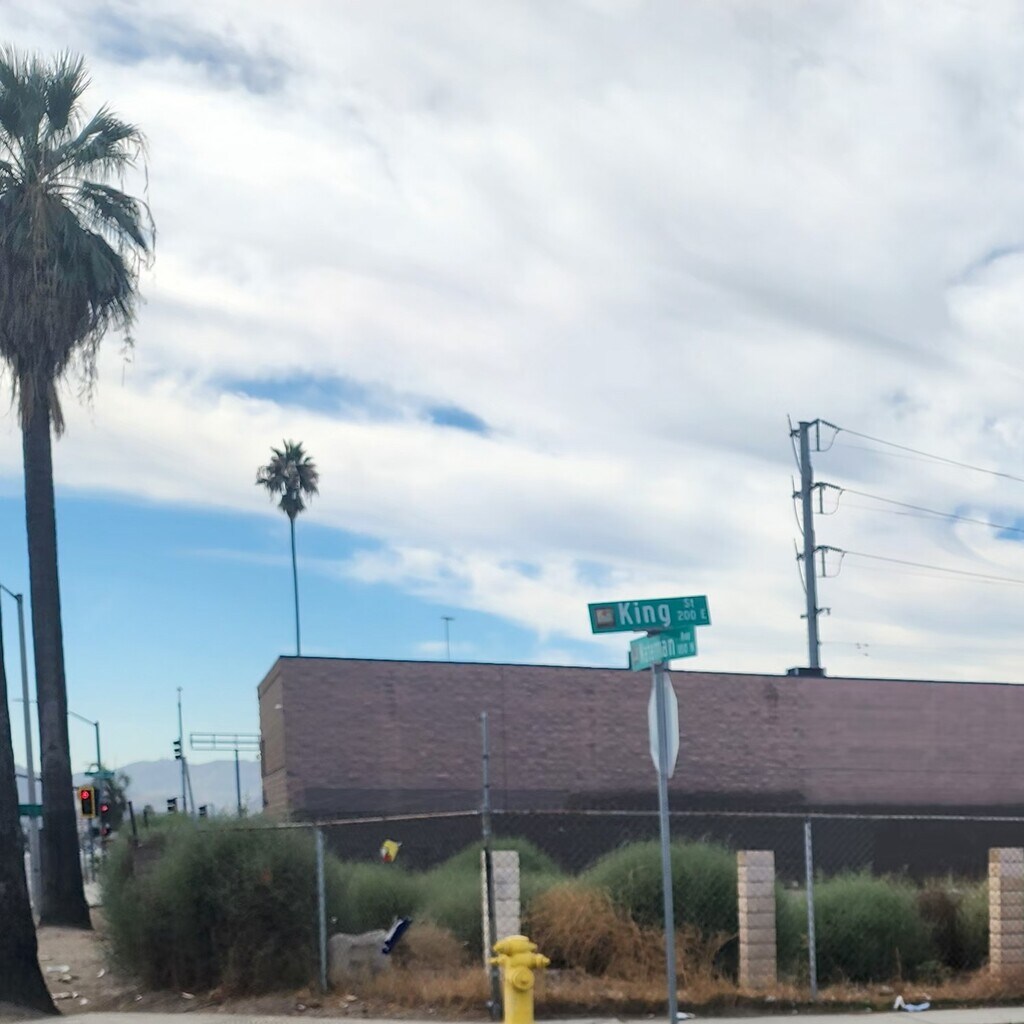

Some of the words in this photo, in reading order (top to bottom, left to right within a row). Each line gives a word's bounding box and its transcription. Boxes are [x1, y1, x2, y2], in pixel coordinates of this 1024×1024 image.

[617, 601, 671, 627] King
[677, 610, 696, 621] 200
[700, 608, 707, 620] E
